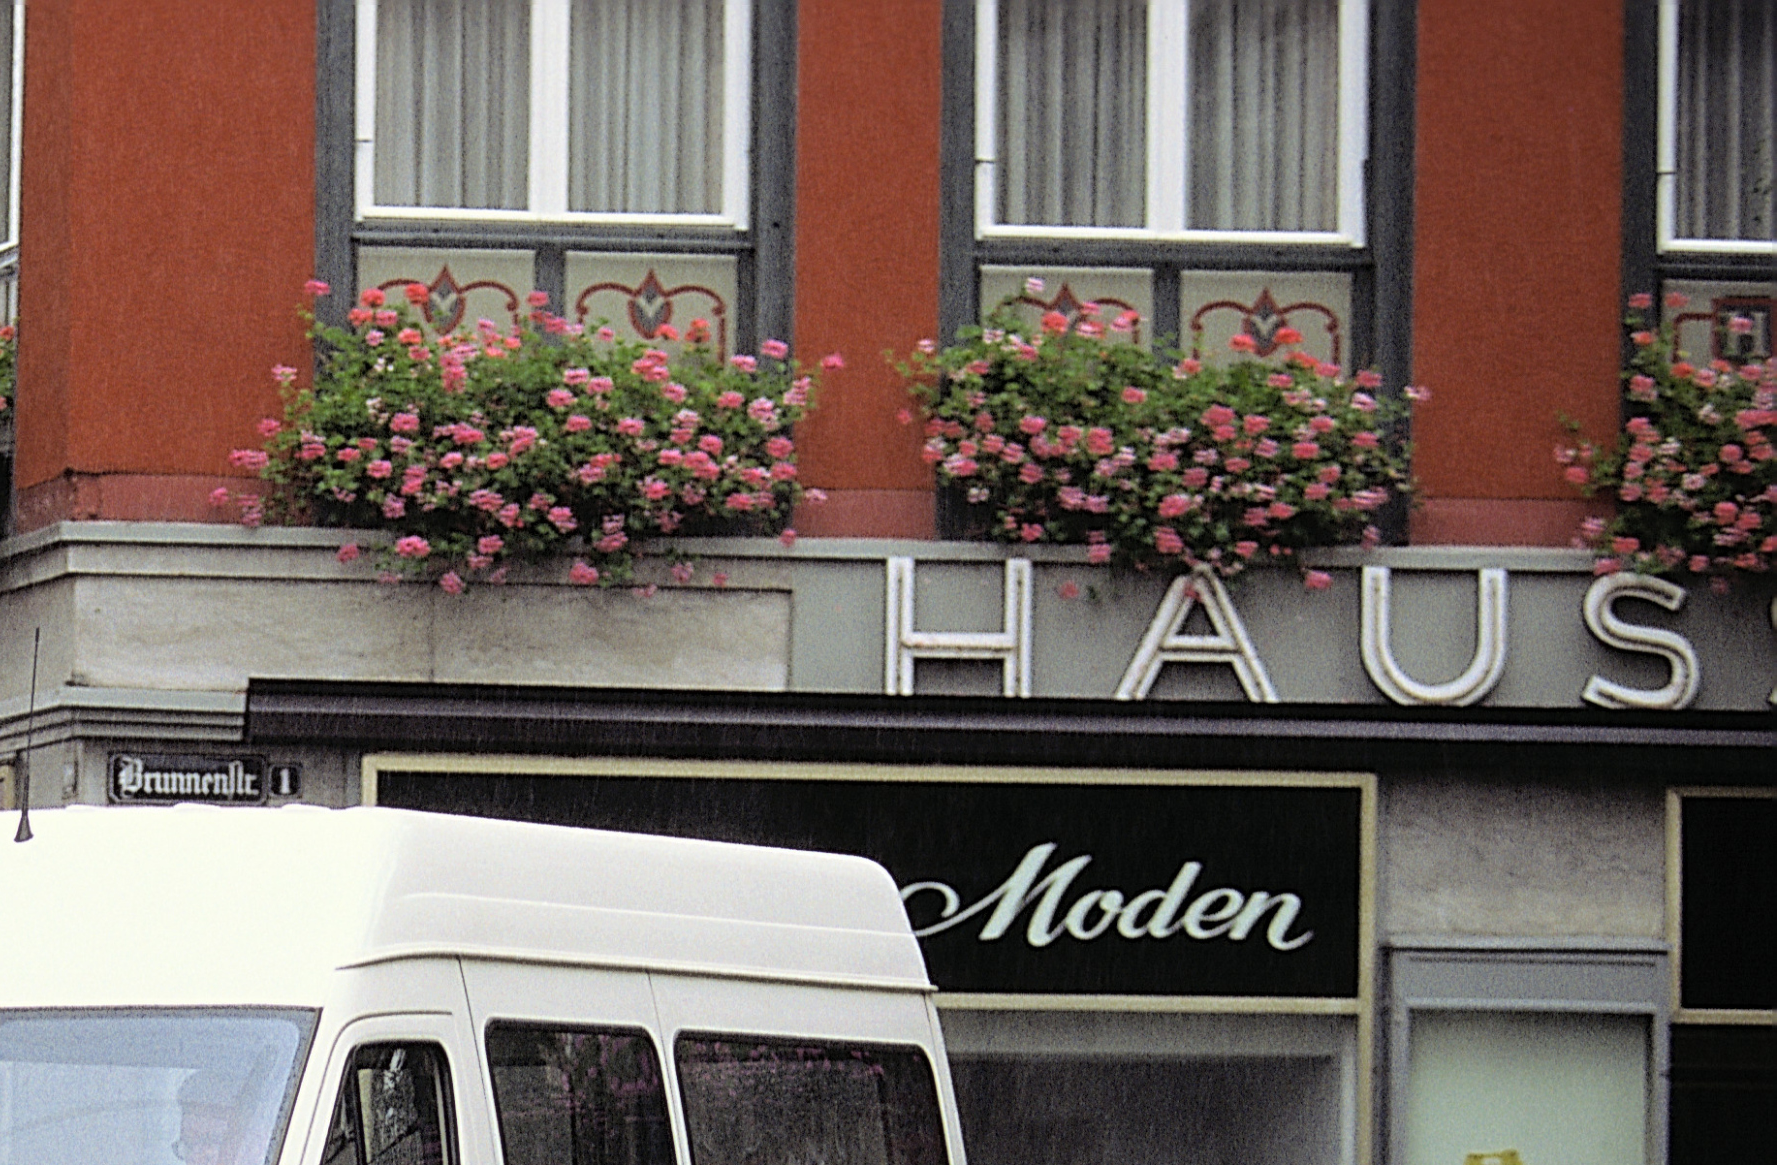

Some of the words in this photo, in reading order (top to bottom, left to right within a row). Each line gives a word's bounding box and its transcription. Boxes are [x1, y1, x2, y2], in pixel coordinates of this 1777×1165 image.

[884, 556, 1777, 710] HAUS
[280, 767, 291, 795] 1
[903, 841, 1314, 951] Moden
